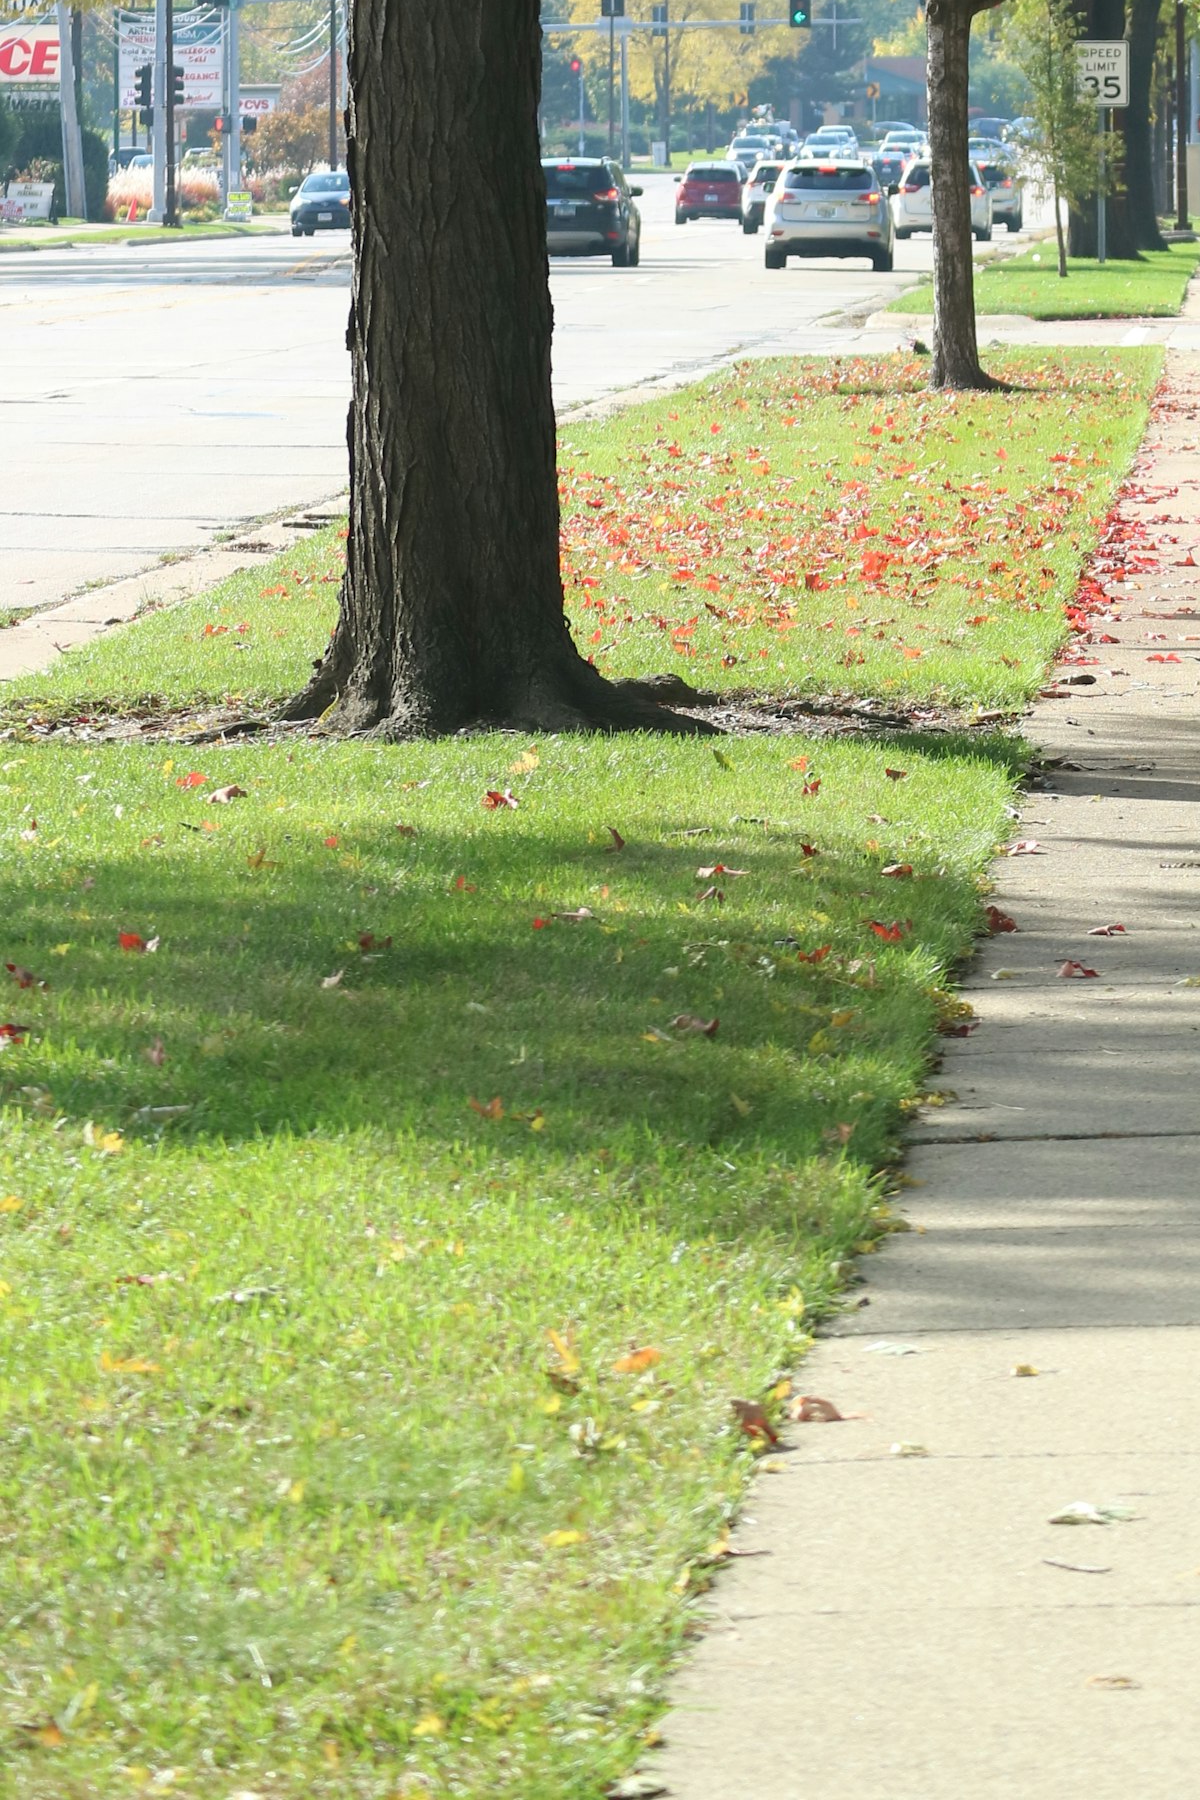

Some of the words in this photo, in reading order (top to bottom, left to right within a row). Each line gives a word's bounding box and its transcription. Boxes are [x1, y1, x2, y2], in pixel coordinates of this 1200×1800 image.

[1080, 48, 1121, 58] SPEED
[1086, 62, 1117, 72] LIMIT
[1084, 76, 1121, 99] 35
[244, 99, 269, 110] CVS
